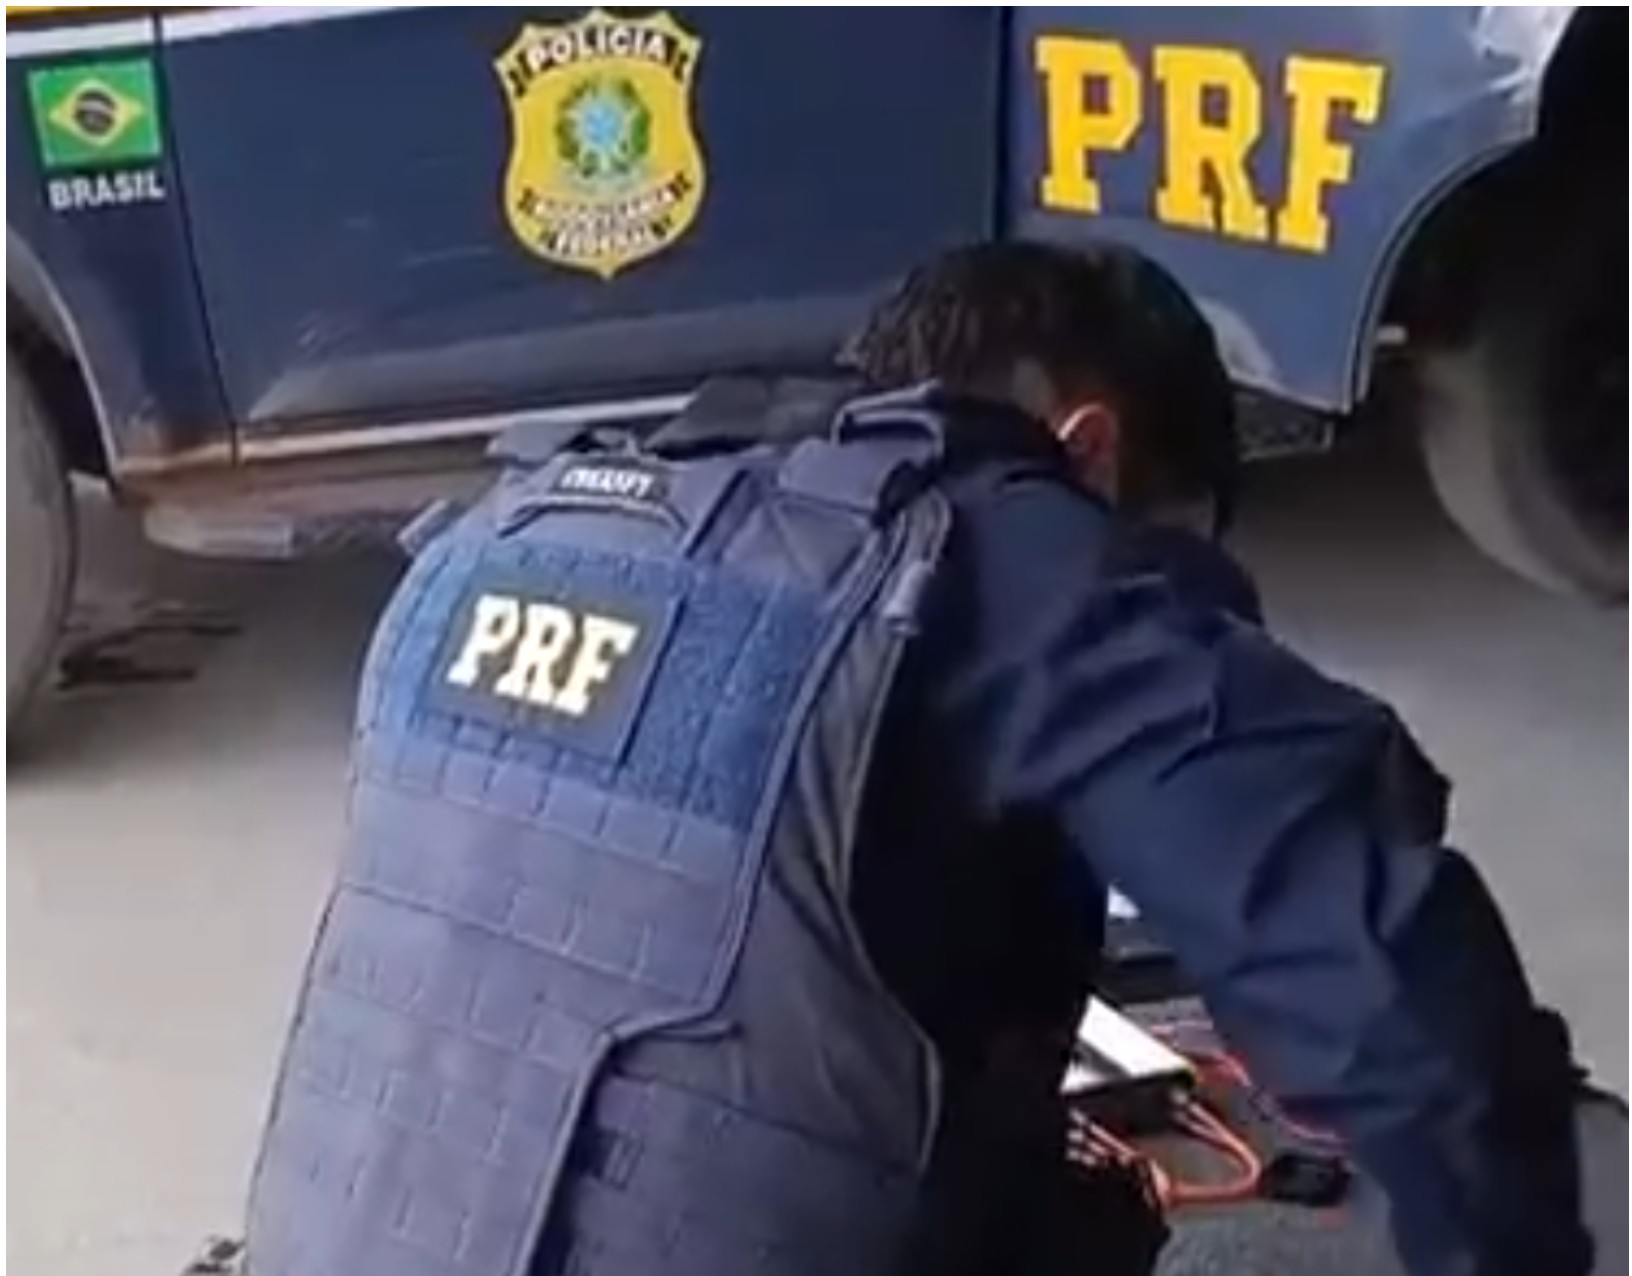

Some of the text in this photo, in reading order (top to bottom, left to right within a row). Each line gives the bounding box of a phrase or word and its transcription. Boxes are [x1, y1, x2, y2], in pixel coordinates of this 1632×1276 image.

[48, 171, 164, 210] BRASIL
[1034, 35, 1384, 252] PRF
[447, 594, 638, 717] PRF
